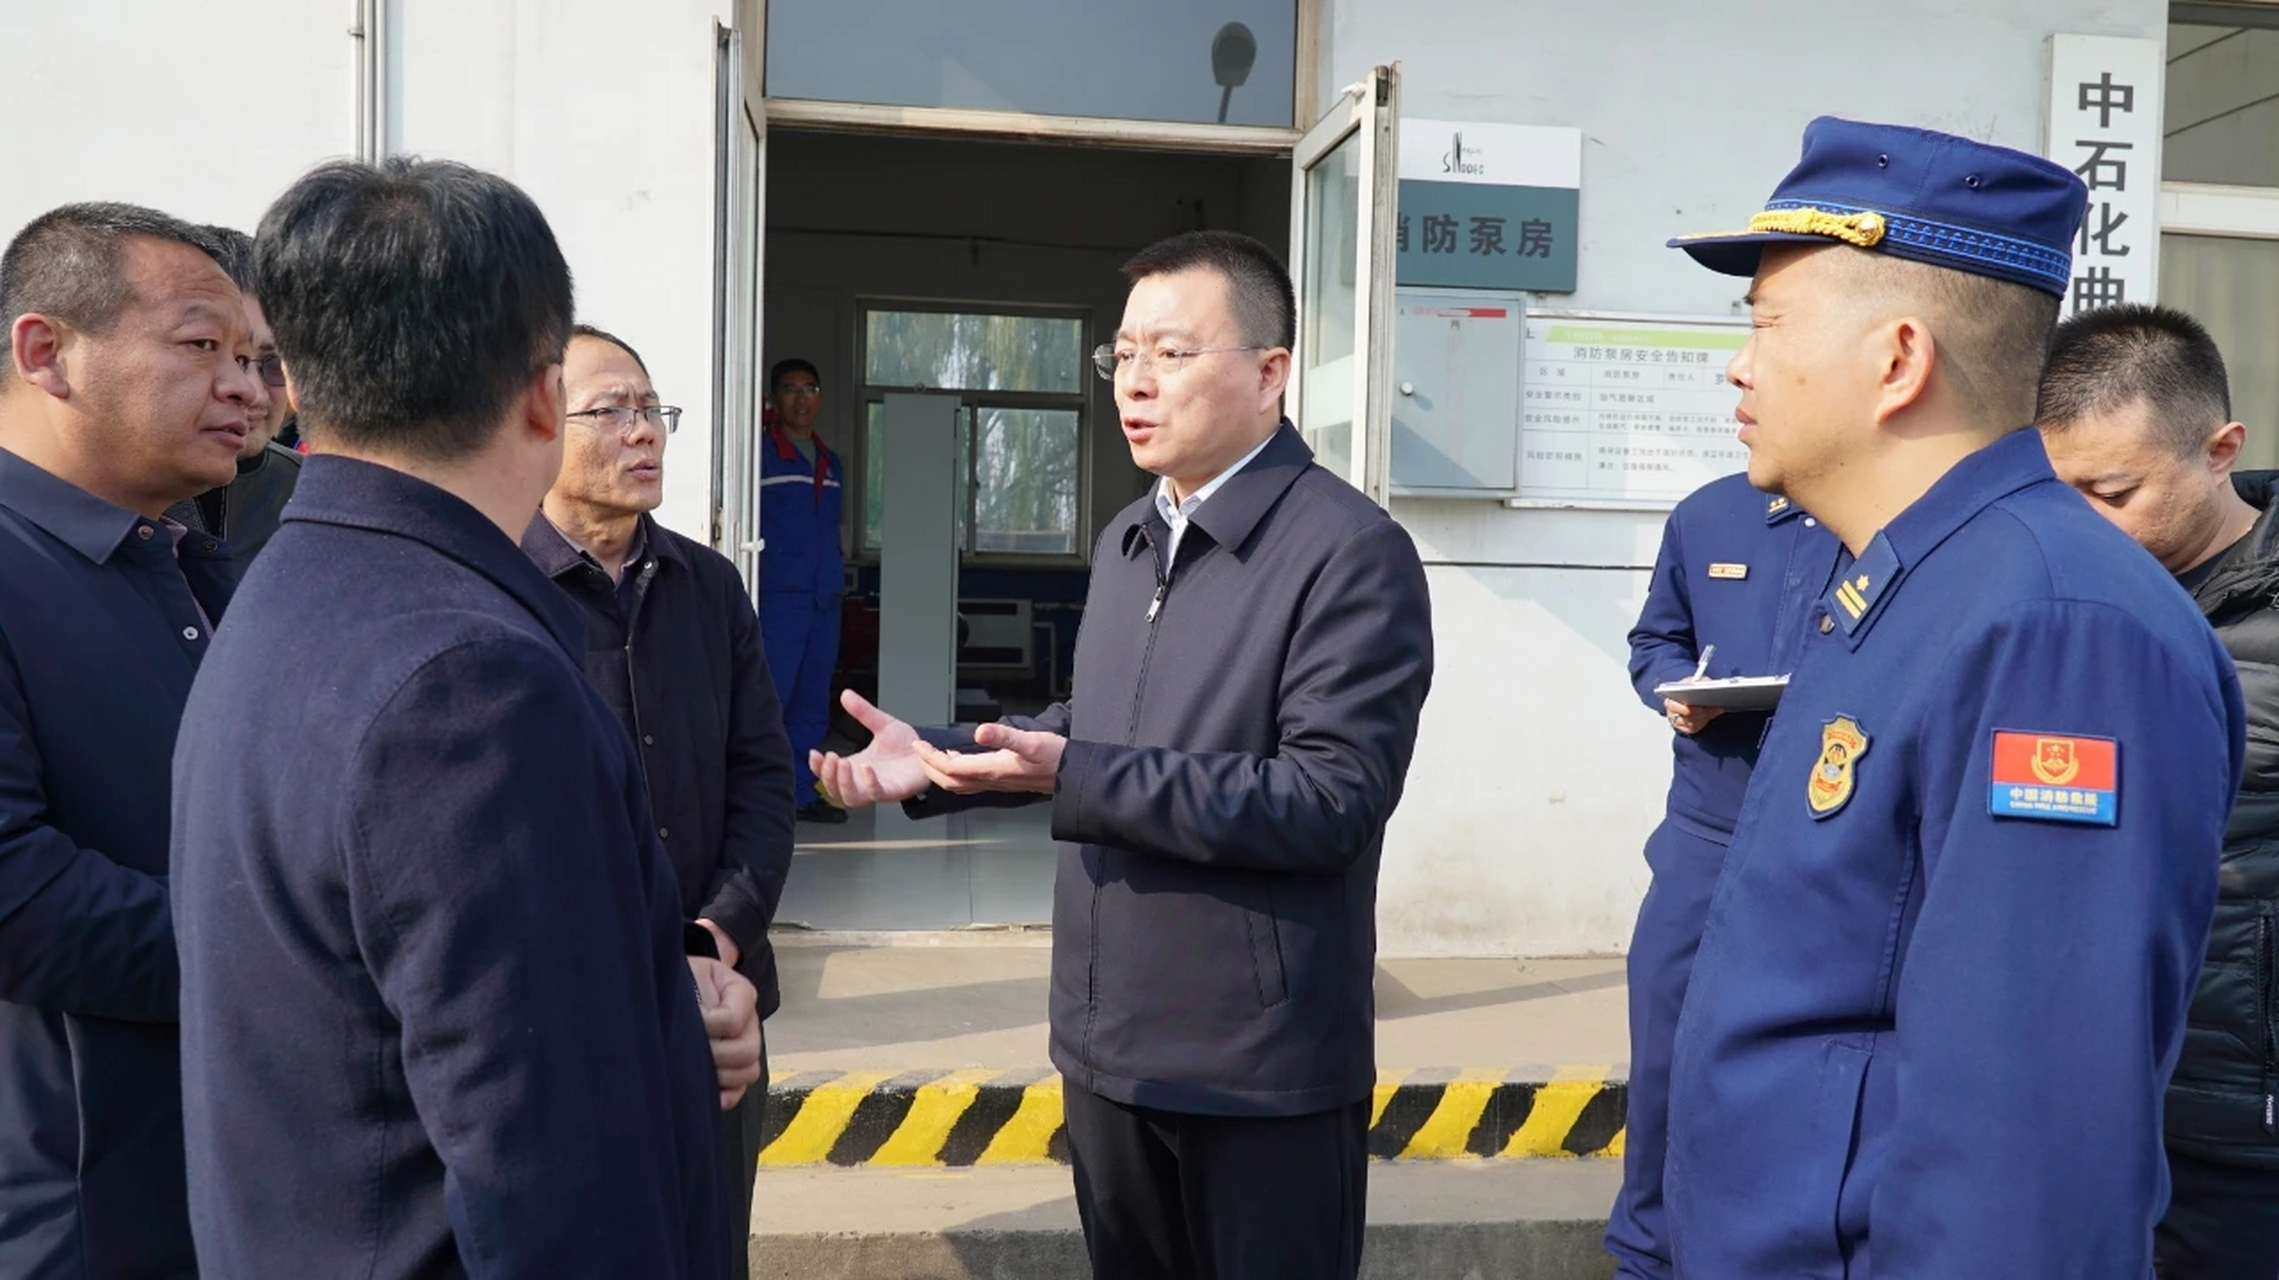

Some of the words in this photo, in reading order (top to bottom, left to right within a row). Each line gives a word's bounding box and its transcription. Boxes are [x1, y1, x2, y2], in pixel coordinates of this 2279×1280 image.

[2074, 72, 2134, 317] 中石化典
[1573, 346, 1709, 364] 消防泵房安全告知牌
